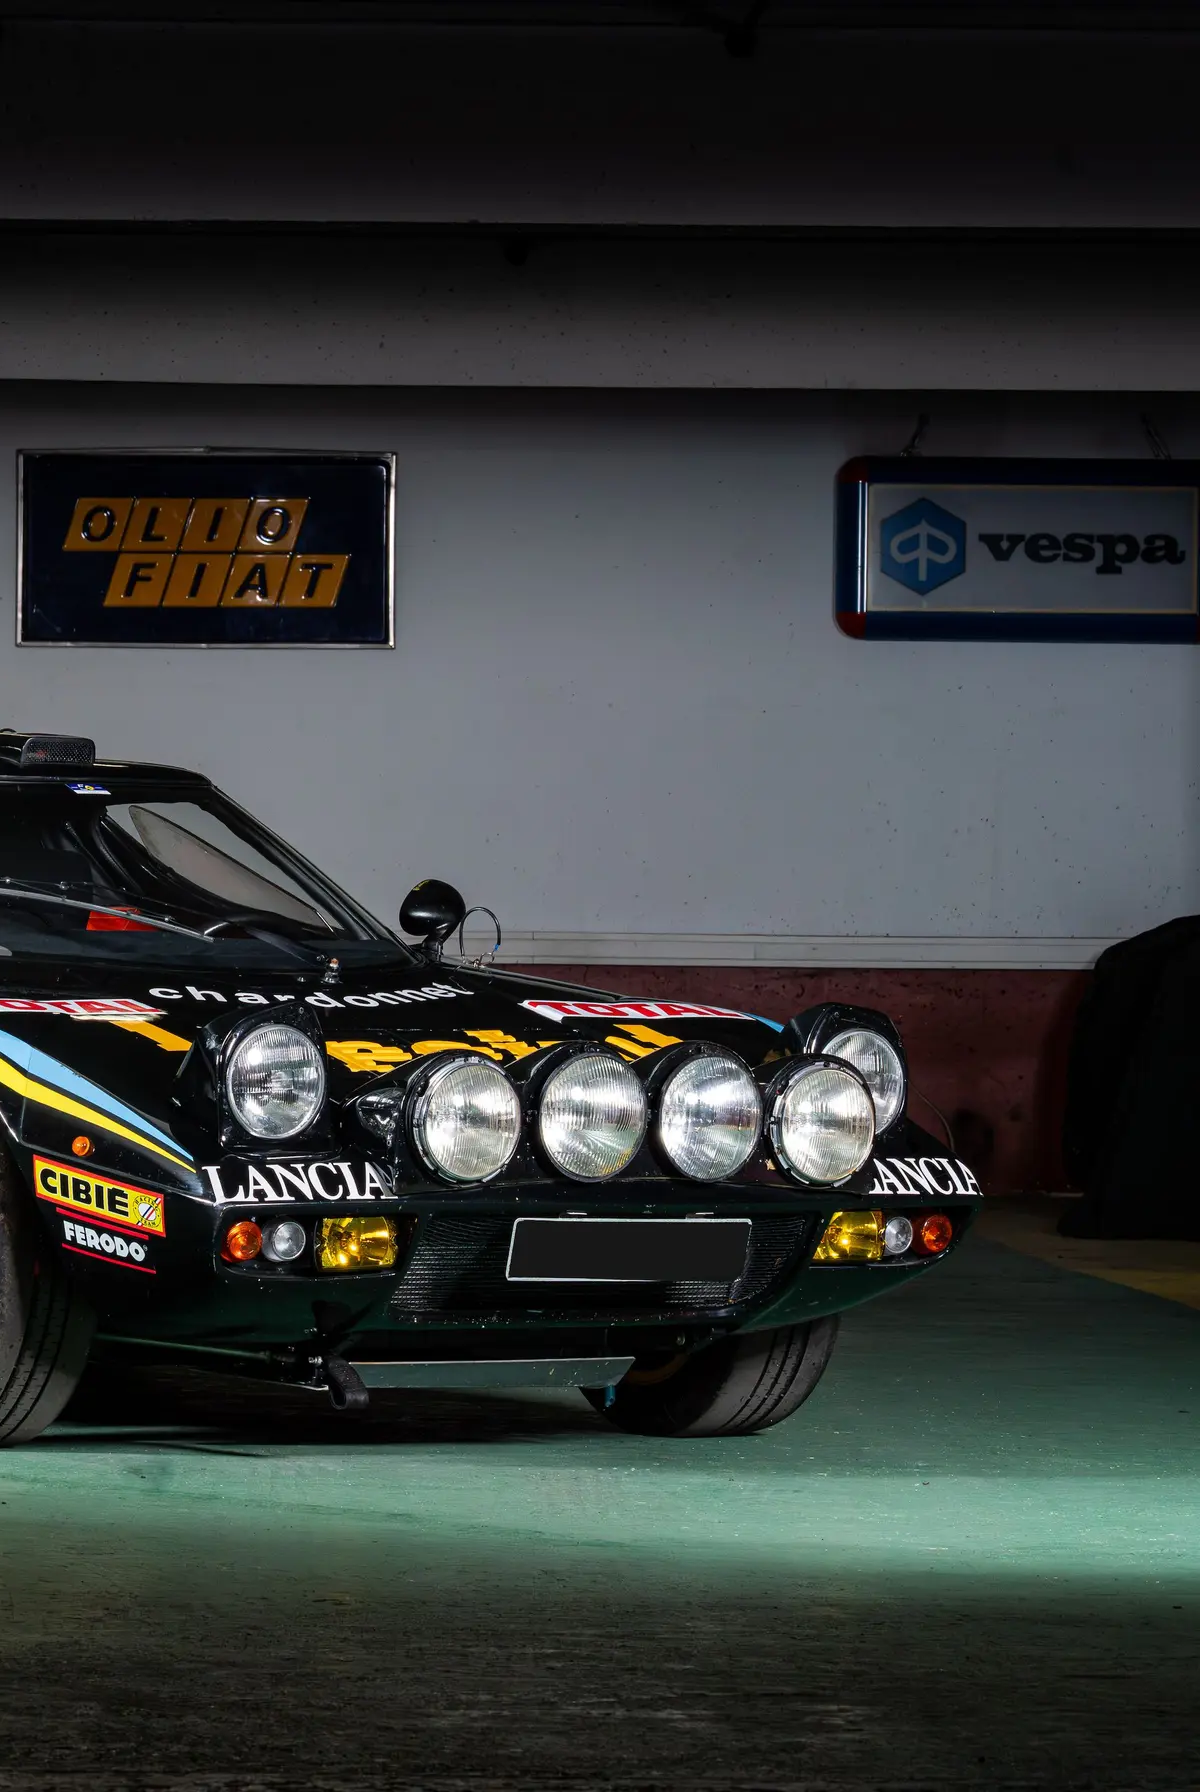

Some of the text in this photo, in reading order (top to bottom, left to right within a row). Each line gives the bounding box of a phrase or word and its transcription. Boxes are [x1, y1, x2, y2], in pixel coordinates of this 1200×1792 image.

[81, 506, 291, 544] OLIO
[978, 532, 1186, 575] vespa
[124, 562, 335, 599] FIAT
[149, 982, 475, 1008] chardonnet
[528, 1001, 746, 1018] TOTAL
[40, 1168, 129, 1217] CIBIÉ
[201, 1161, 399, 1206] LANCIA
